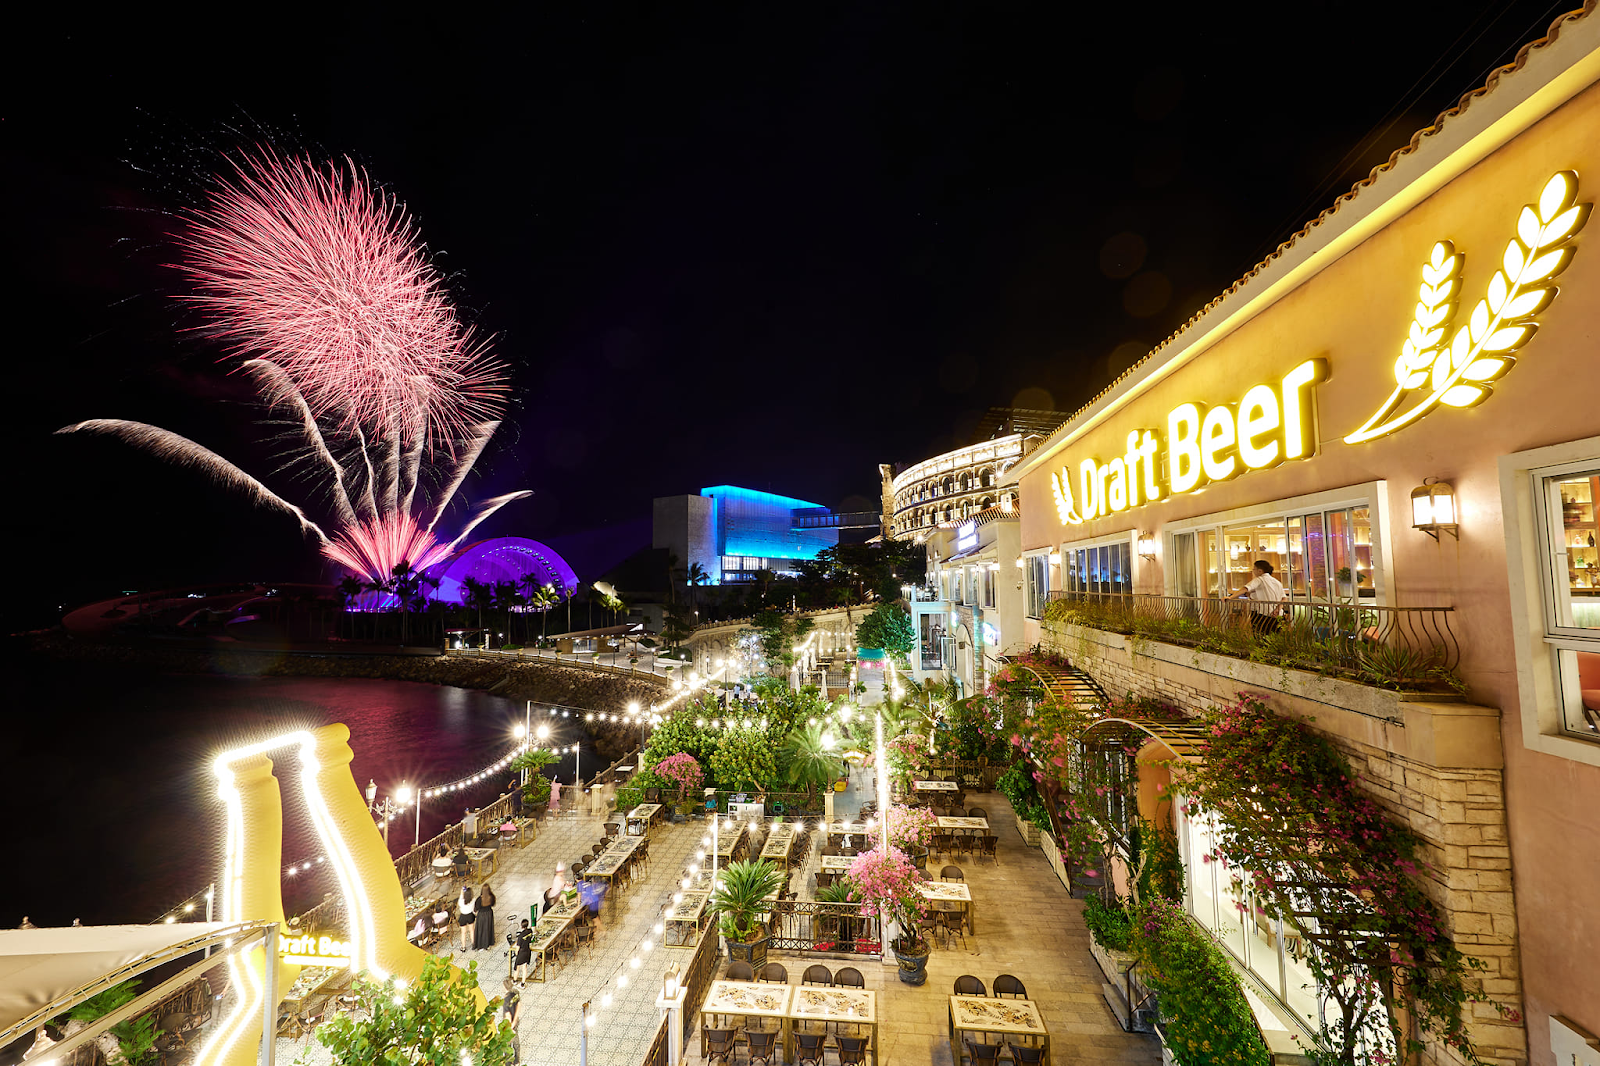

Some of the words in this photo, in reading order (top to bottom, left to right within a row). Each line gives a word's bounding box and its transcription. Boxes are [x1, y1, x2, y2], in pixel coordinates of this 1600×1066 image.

[1080, 428, 1159, 520] Draft
[1168, 359, 1316, 494] Beer
[319, 936, 351, 957] Bee
